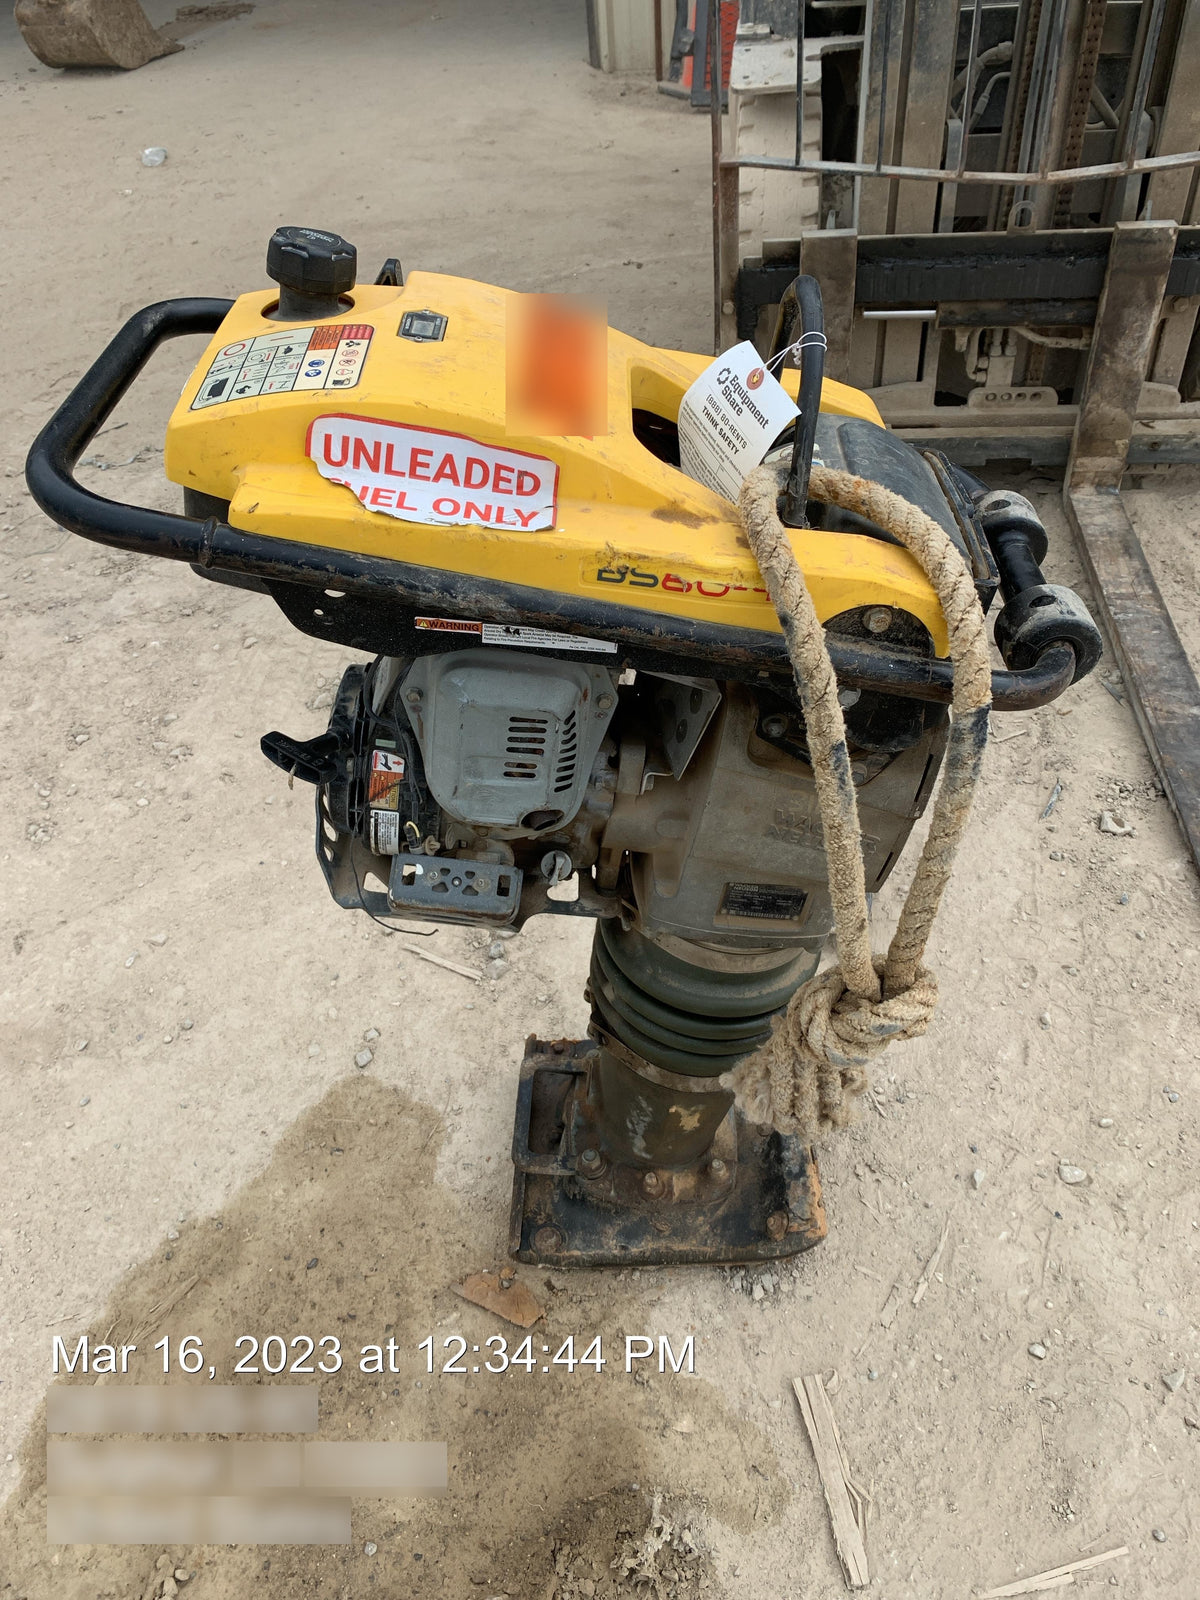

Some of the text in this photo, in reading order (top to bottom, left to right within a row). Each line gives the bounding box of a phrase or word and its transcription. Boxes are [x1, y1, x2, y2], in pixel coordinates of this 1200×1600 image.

[705, 393, 748, 449] (888) 80-RENTS
[721, 384, 744, 417] Share
[729, 374, 771, 430] Equipment
[702, 406, 740, 455] THINK SAFETY
[323, 433, 541, 497] UNLEADED
[432, 497, 539, 528] ONLY
[429, 619, 480, 632] WARNING
